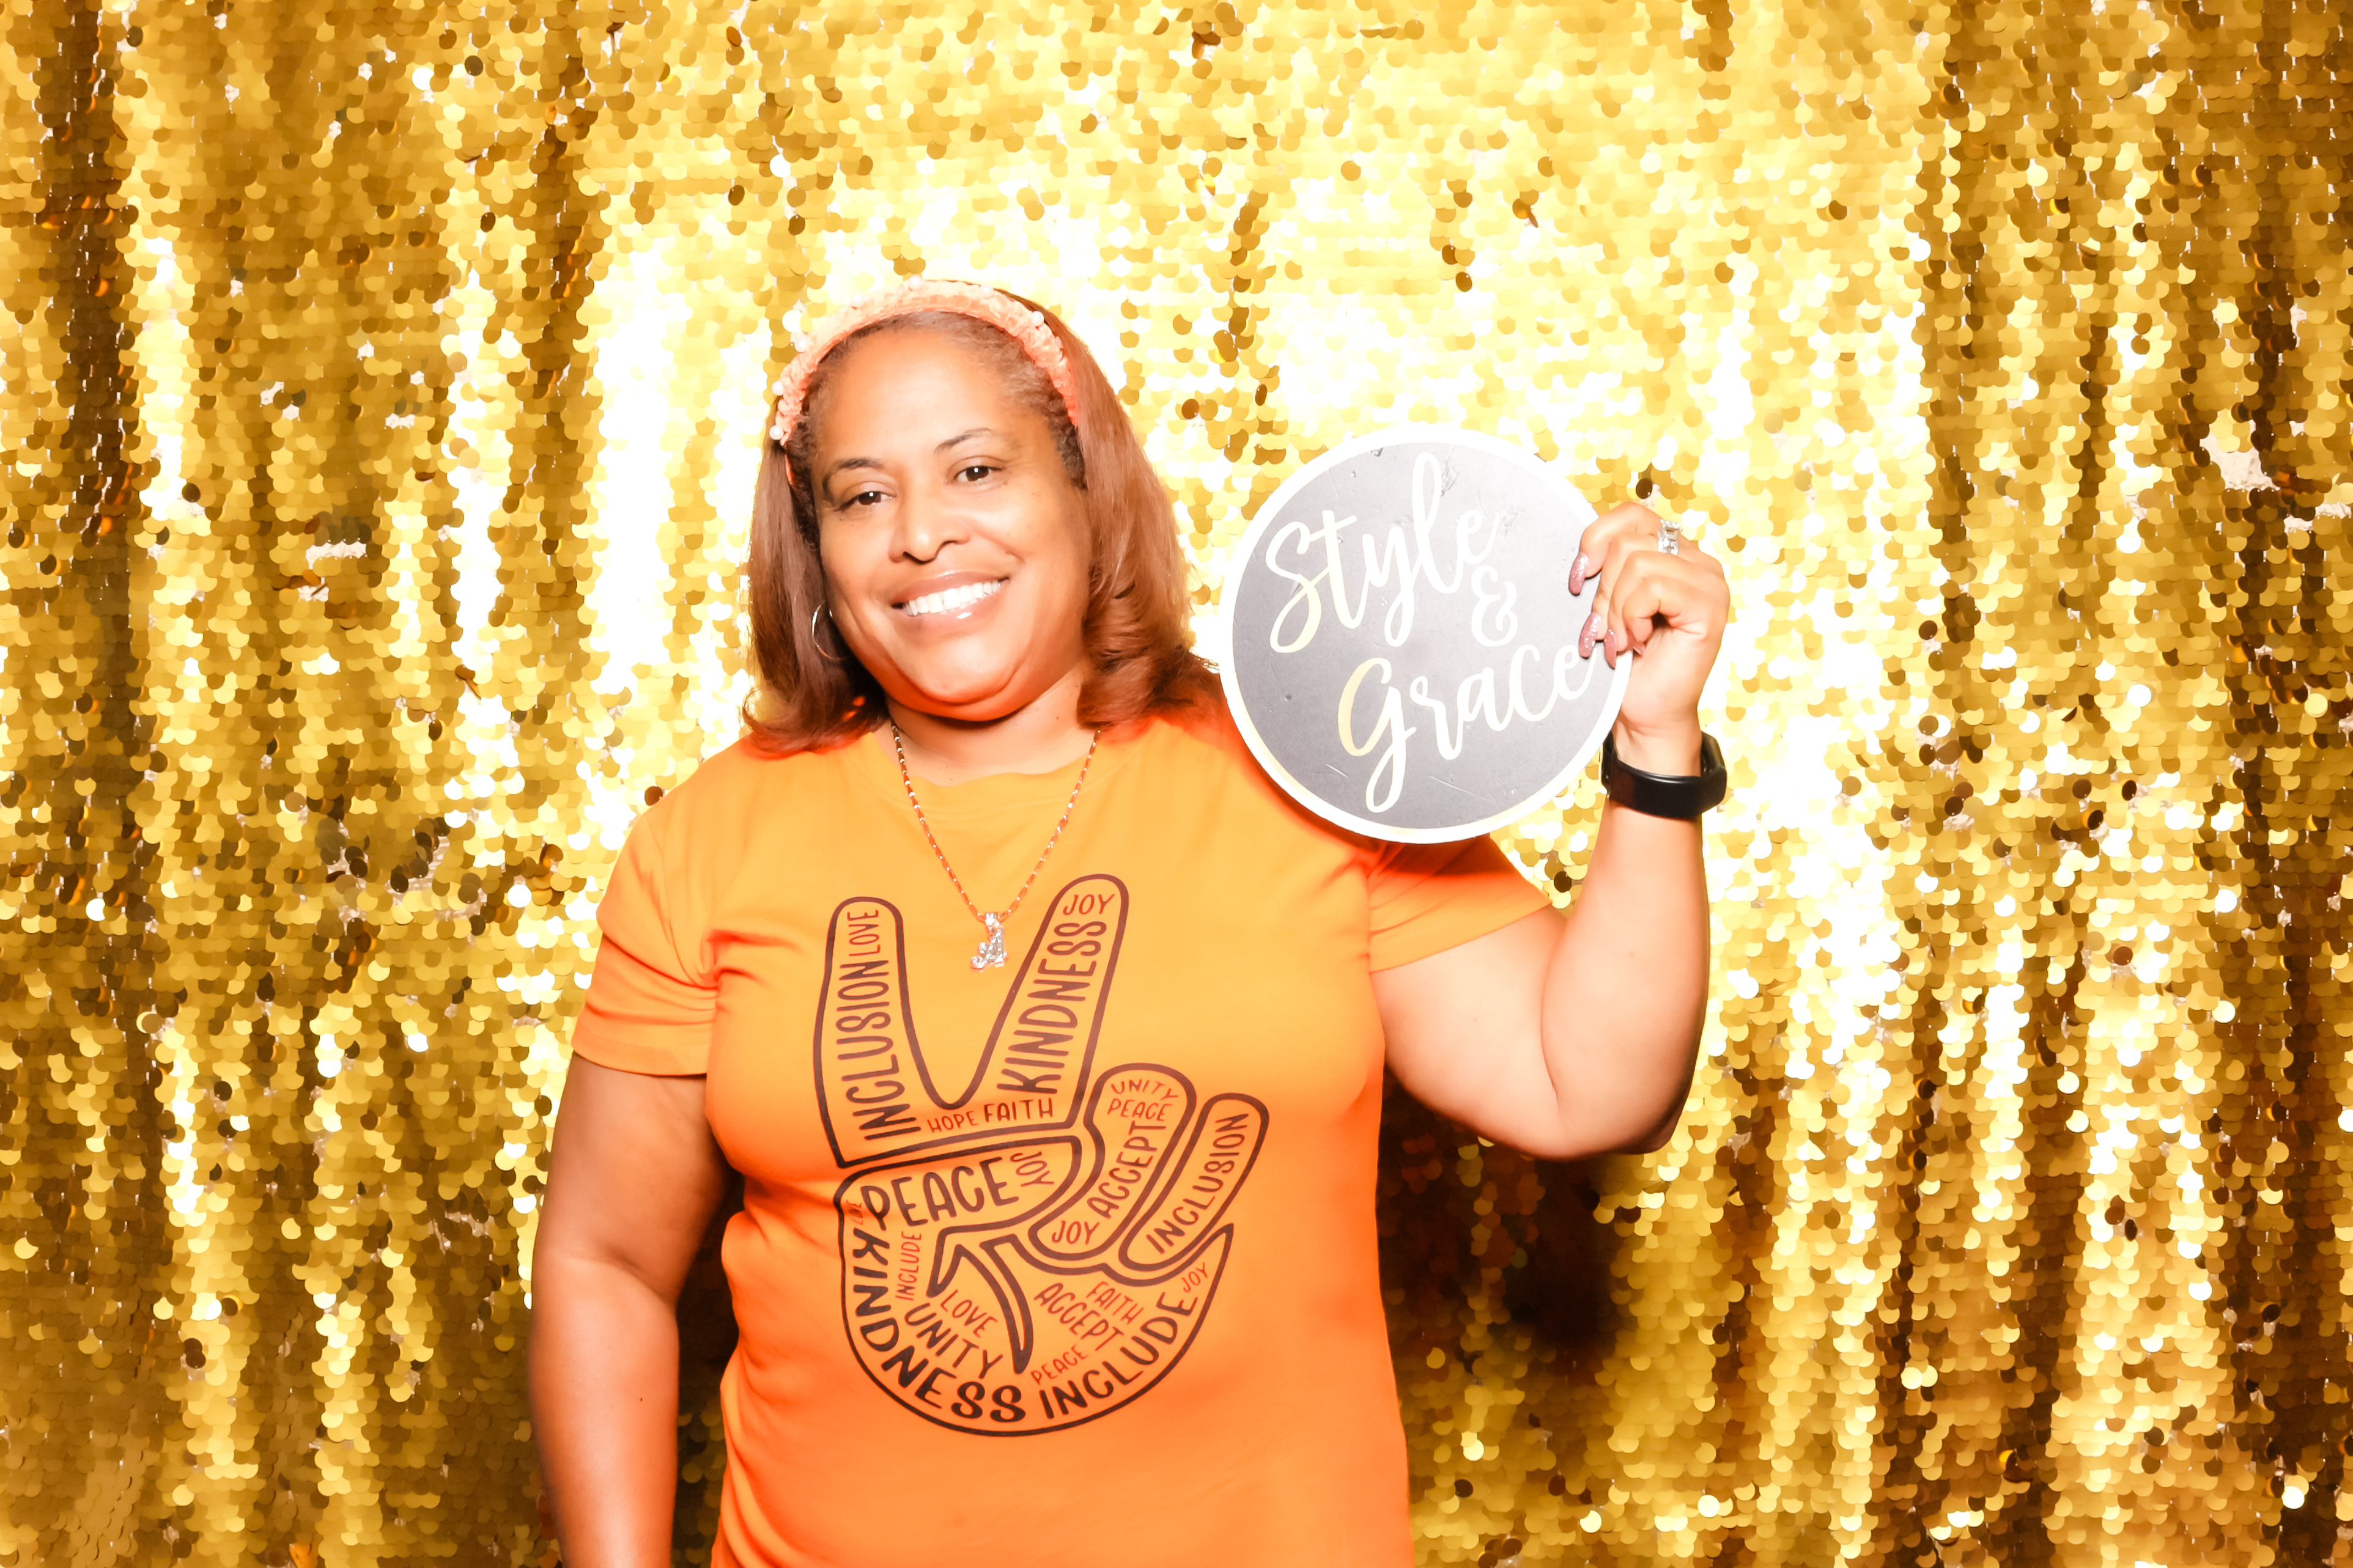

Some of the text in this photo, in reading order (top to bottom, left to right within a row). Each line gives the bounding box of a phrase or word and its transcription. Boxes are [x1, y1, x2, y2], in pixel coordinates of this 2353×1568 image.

[1265, 452, 1500, 653] Style
[1471, 566, 1518, 647] &
[1338, 645, 1597, 812] Grace
[847, 908, 881, 957] LOVE
[1063, 893, 1115, 916] JOY
[996, 921, 1108, 1094] KINDNESS
[835, 960, 922, 1141] INCLUSION
[927, 1097, 1054, 1133] HOPE FAITH
[1107, 1098, 1172, 1122] PEACE
[1110, 1078, 1179, 1099] UNITY
[860, 1157, 1019, 1231] PEACE
[1010, 1149, 1055, 1188] JOY
[1087, 1120, 1167, 1219] ACCEPT
[1146, 1113, 1249, 1255] INCLUSION
[895, 1231, 922, 1302] INCLUDE
[1051, 1220, 1101, 1245] JOY
[852, 1228, 1209, 1423] KINDNESS INCLUDE JOY
[940, 1289, 998, 1339] LOVE
[1033, 1282, 1125, 1352] ACCEPT
[1085, 1281, 1145, 1325] FAITH
[904, 1303, 1003, 1380] UNITY
[1030, 1344, 1089, 1386] PEACE
